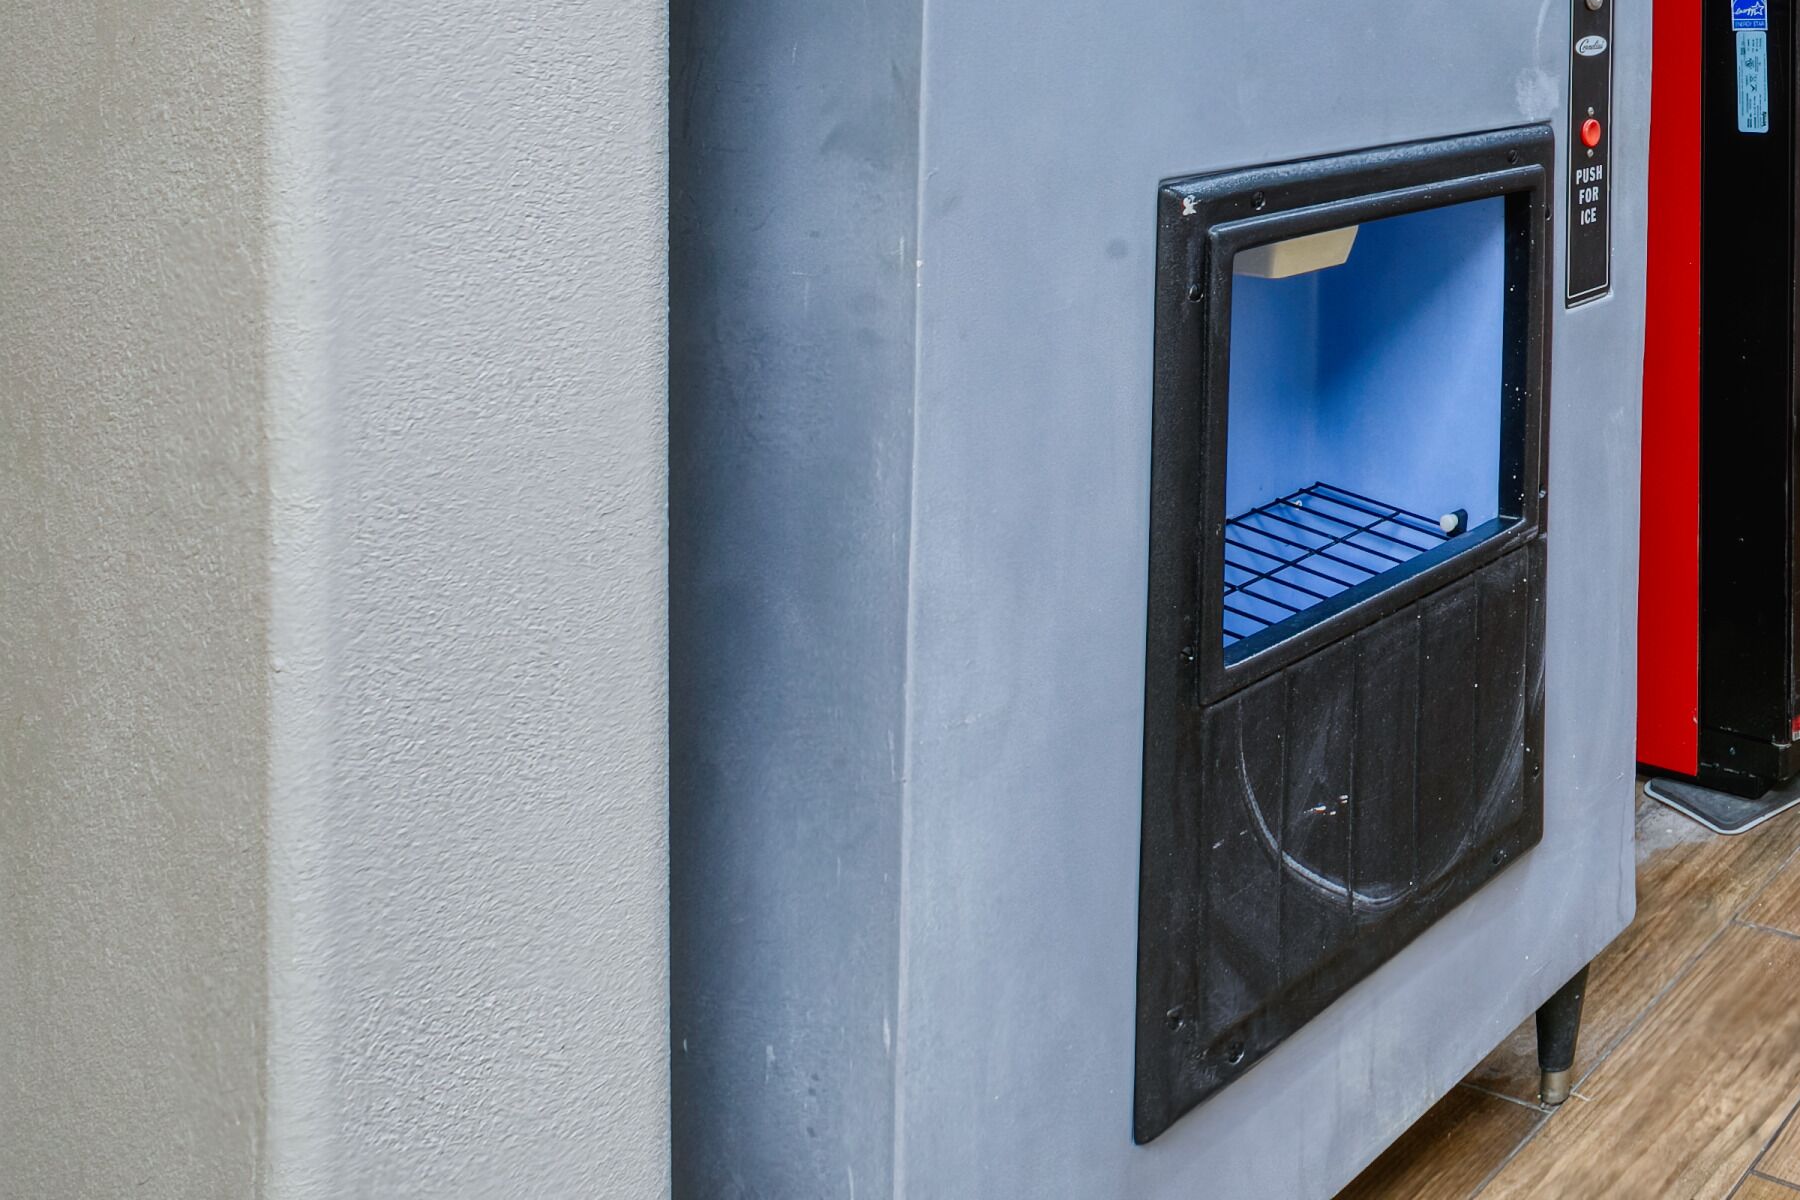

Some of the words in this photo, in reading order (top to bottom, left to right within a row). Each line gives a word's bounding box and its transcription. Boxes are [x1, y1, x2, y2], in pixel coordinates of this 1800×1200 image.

[1576, 164, 1603, 185] PUSH
[1579, 186, 1599, 205] FOR
[1580, 207, 1597, 225] ICE
